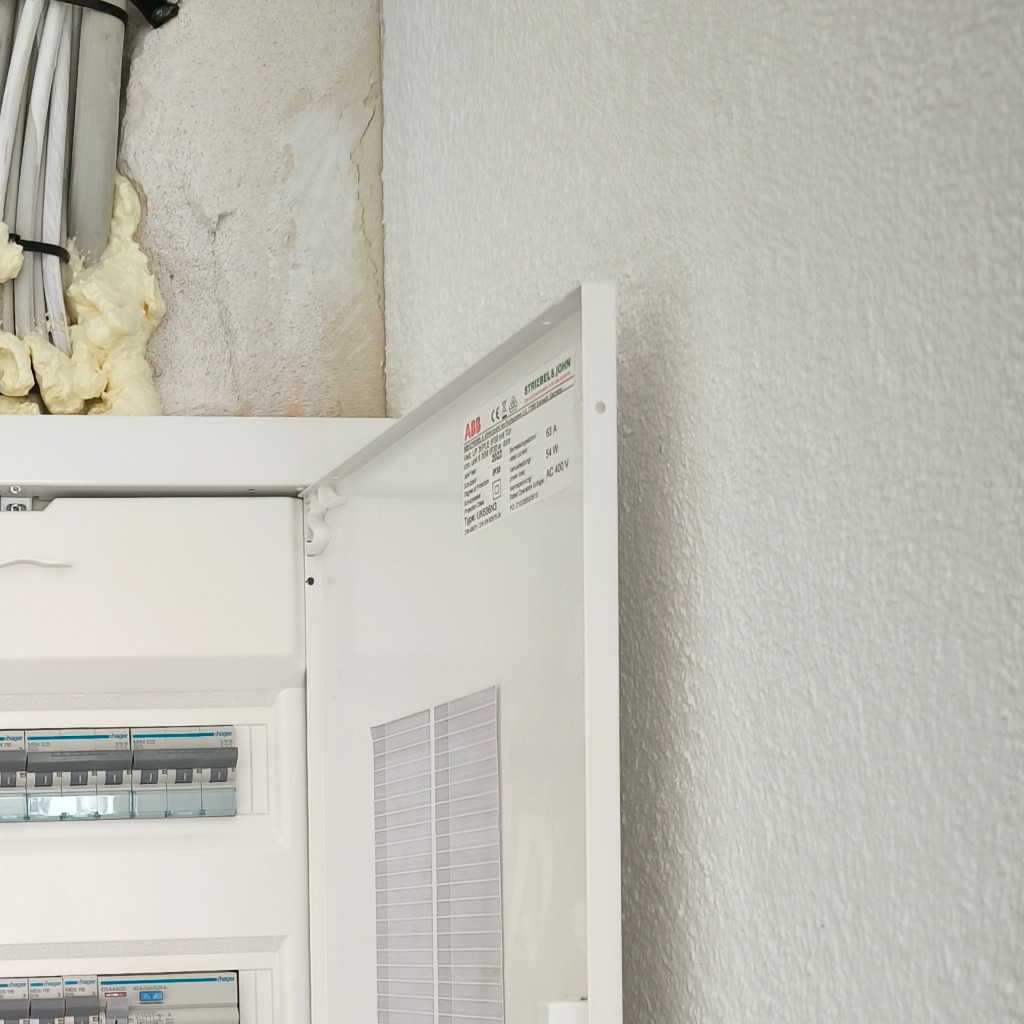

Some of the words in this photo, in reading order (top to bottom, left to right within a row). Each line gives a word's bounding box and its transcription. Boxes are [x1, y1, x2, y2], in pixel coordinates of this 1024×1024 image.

[524, 371, 551, 396] STRIEBEL
[555, 357, 571, 377] JOHN
[465, 416, 481, 441] ABB
[545, 426, 552, 438] 63
[554, 461, 564, 474] 400
